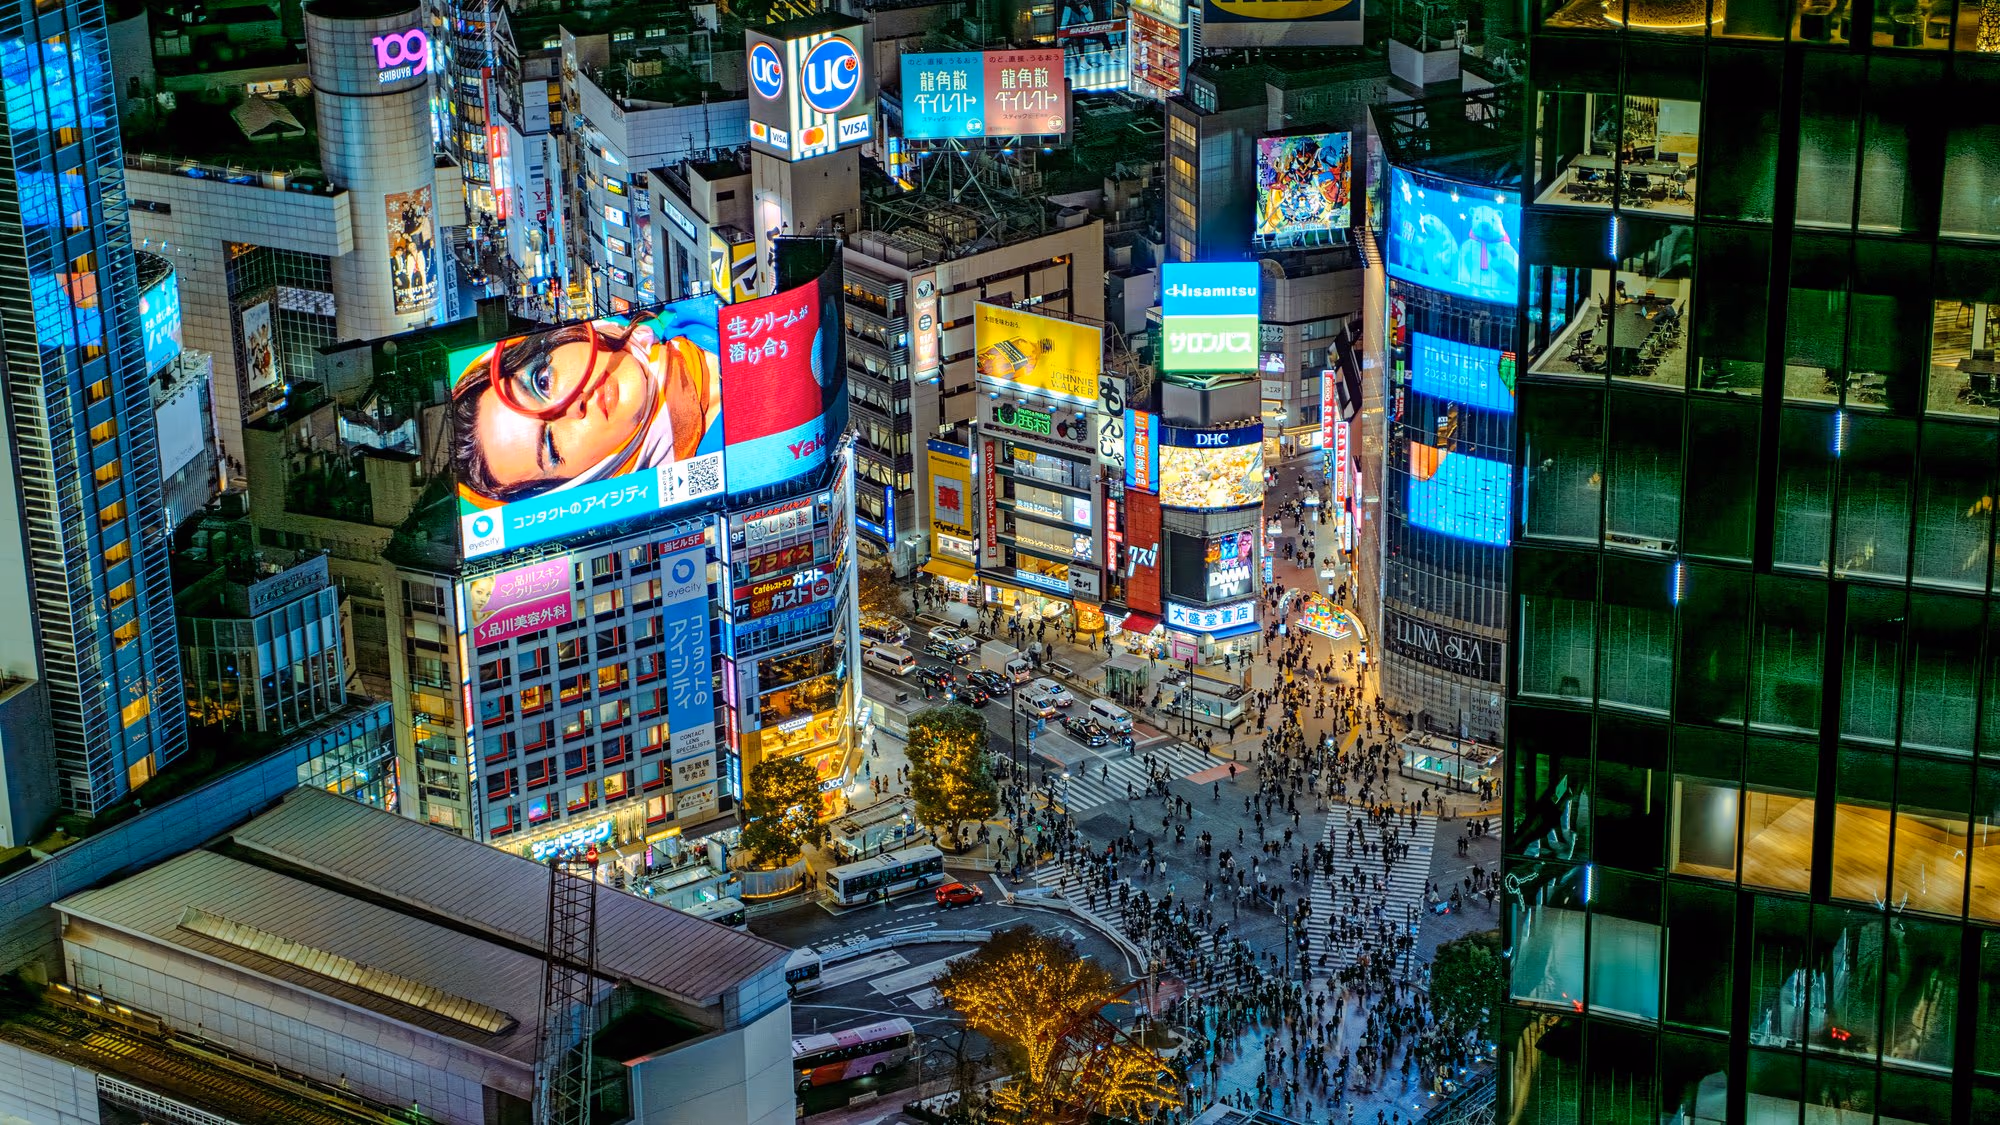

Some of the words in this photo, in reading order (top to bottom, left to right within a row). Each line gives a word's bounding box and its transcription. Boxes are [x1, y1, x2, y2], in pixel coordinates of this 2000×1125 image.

[1069, 24, 1114, 35] SKECHERS
[372, 29, 428, 76] 109
[379, 66, 411, 82] SHIBUYA
[753, 55, 780, 87] UC
[808, 55, 856, 94] UC
[920, 69, 967, 92] 龍角散
[1001, 67, 1048, 90] 龍角散
[914, 93, 977, 114] ダイレクト
[995, 90, 1058, 111] ダイレクト
[772, 132, 787, 144] VISA
[842, 121, 868, 136] VISA
[1165, 283, 1257, 298] Hisamitsu
[728, 305, 808, 339] 生クリームが
[729, 337, 789, 365] 溶け合う
[1169, 332, 1252, 353] サロンパス
[1425, 347, 1485, 372] MUTEK
[1051, 371, 1094, 387] JOHNNIE
[1051, 380, 1094, 396] WALKER
[1018, 415, 1050, 435] 西村
[1323, 405, 1333, 444] カラオケ
[788, 430, 826, 460] Yak
[1195, 432, 1230, 446] DHC
[1337, 427, 1346, 469] カラオケ
[1135, 416, 1147, 485] 三千里薬品
[513, 484, 649, 530] コンタクトのアイシティ
[938, 486, 960, 511] 薬
[769, 510, 808, 534] しゃぶ葉
[468, 535, 505, 550] eyecity
[663, 534, 701, 554] 当ビル5F
[731, 531, 744, 543] 9F
[1128, 542, 1158, 577] クスリ
[514, 565, 564, 587] 品川スキン
[793, 568, 825, 587] ガスト
[1210, 566, 1249, 587] DMM
[516, 578, 559, 598] クリニック
[667, 583, 701, 598] eyecity
[1220, 581, 1239, 597] TV
[771, 587, 808, 611] ガスト
[488, 603, 567, 638] 品川美容外科
[735, 603, 749, 617] 7F
[1173, 606, 1249, 627] 大盛堂書店
[1397, 618, 1442, 654] LUNA
[1445, 635, 1484, 666] SEA
[670, 619, 690, 709] アイシティ
[691, 615, 707, 706] コンタクトの
[1472, 704, 1499, 717] TSUTAYA
[680, 729, 704, 741] CONTACT
[356, 743, 391, 766] CITY
[676, 740, 710, 755] SPECIALISTS
[683, 769, 706, 782] 专卖店
[532, 821, 611, 860] サンドラッグ
